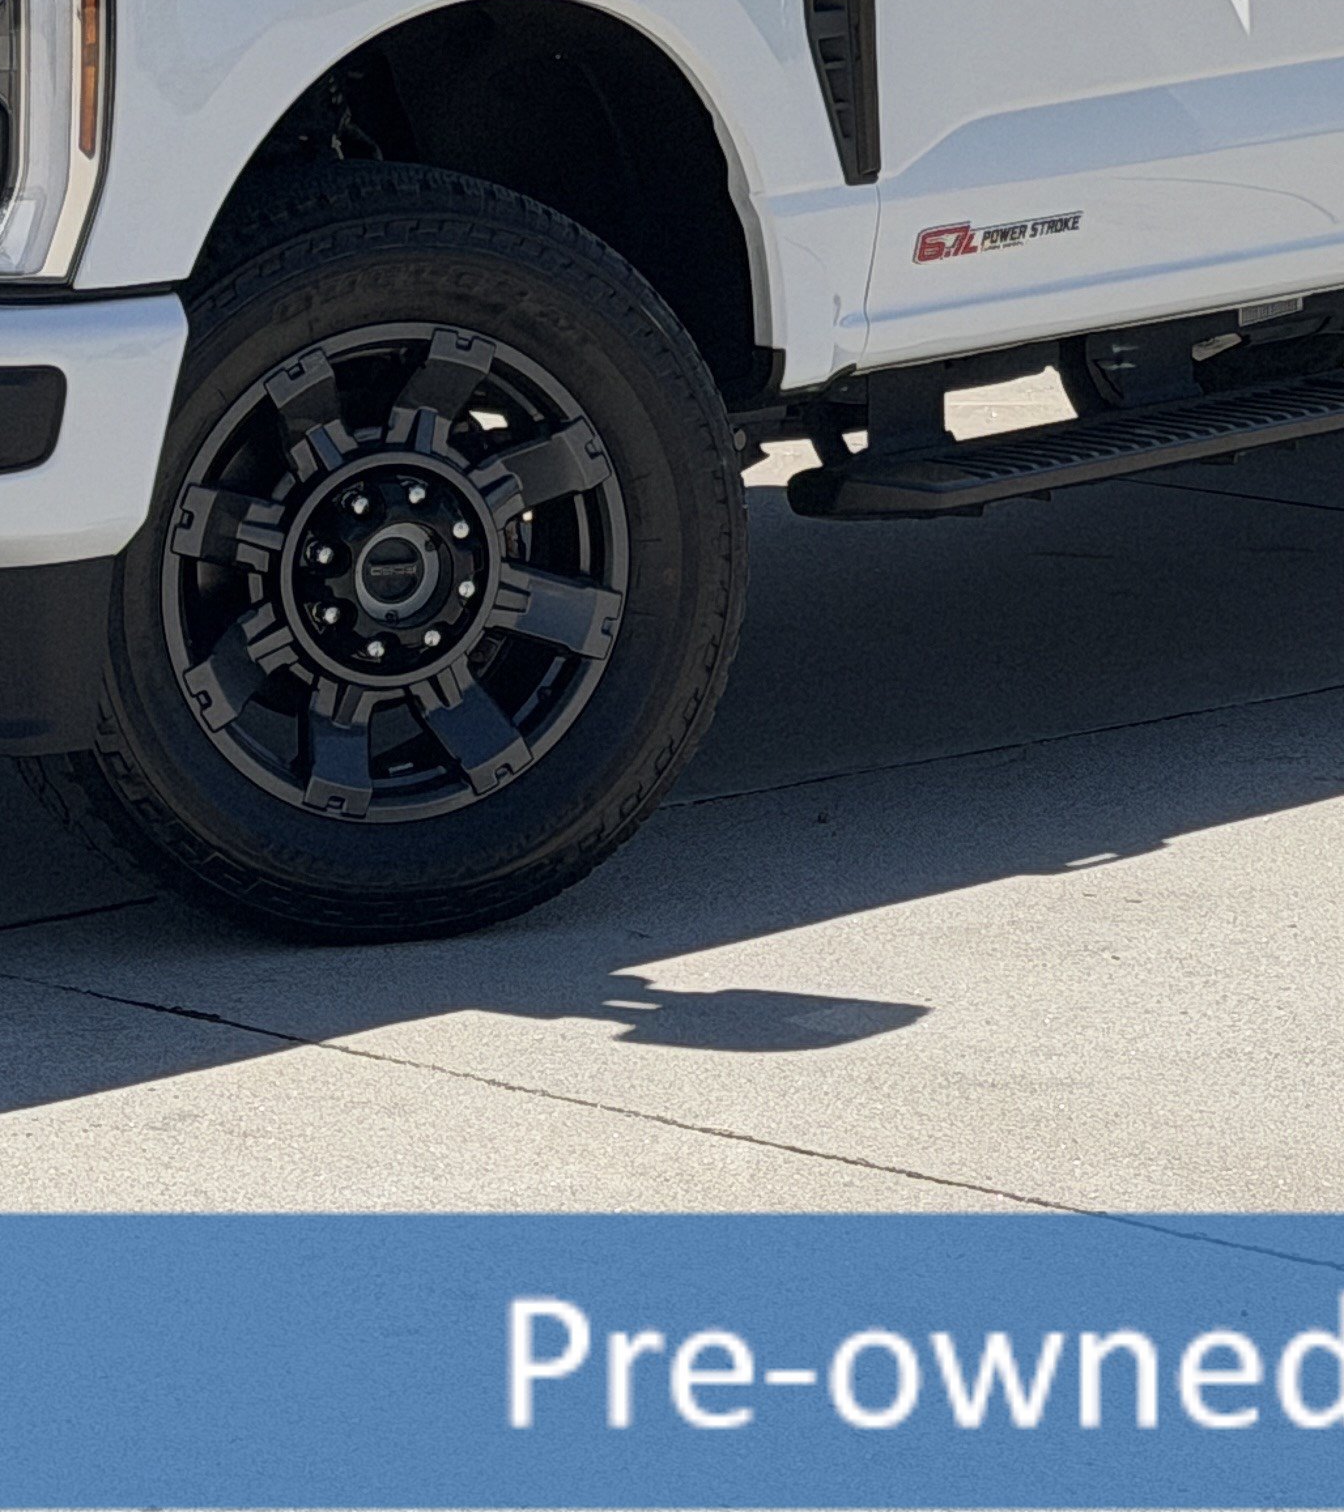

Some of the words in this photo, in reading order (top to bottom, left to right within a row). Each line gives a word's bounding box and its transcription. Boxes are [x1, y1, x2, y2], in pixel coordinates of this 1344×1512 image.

[917, 225, 978, 262] 6.7L
[981, 224, 1027, 247] POWER
[1029, 215, 1082, 238] STROKE
